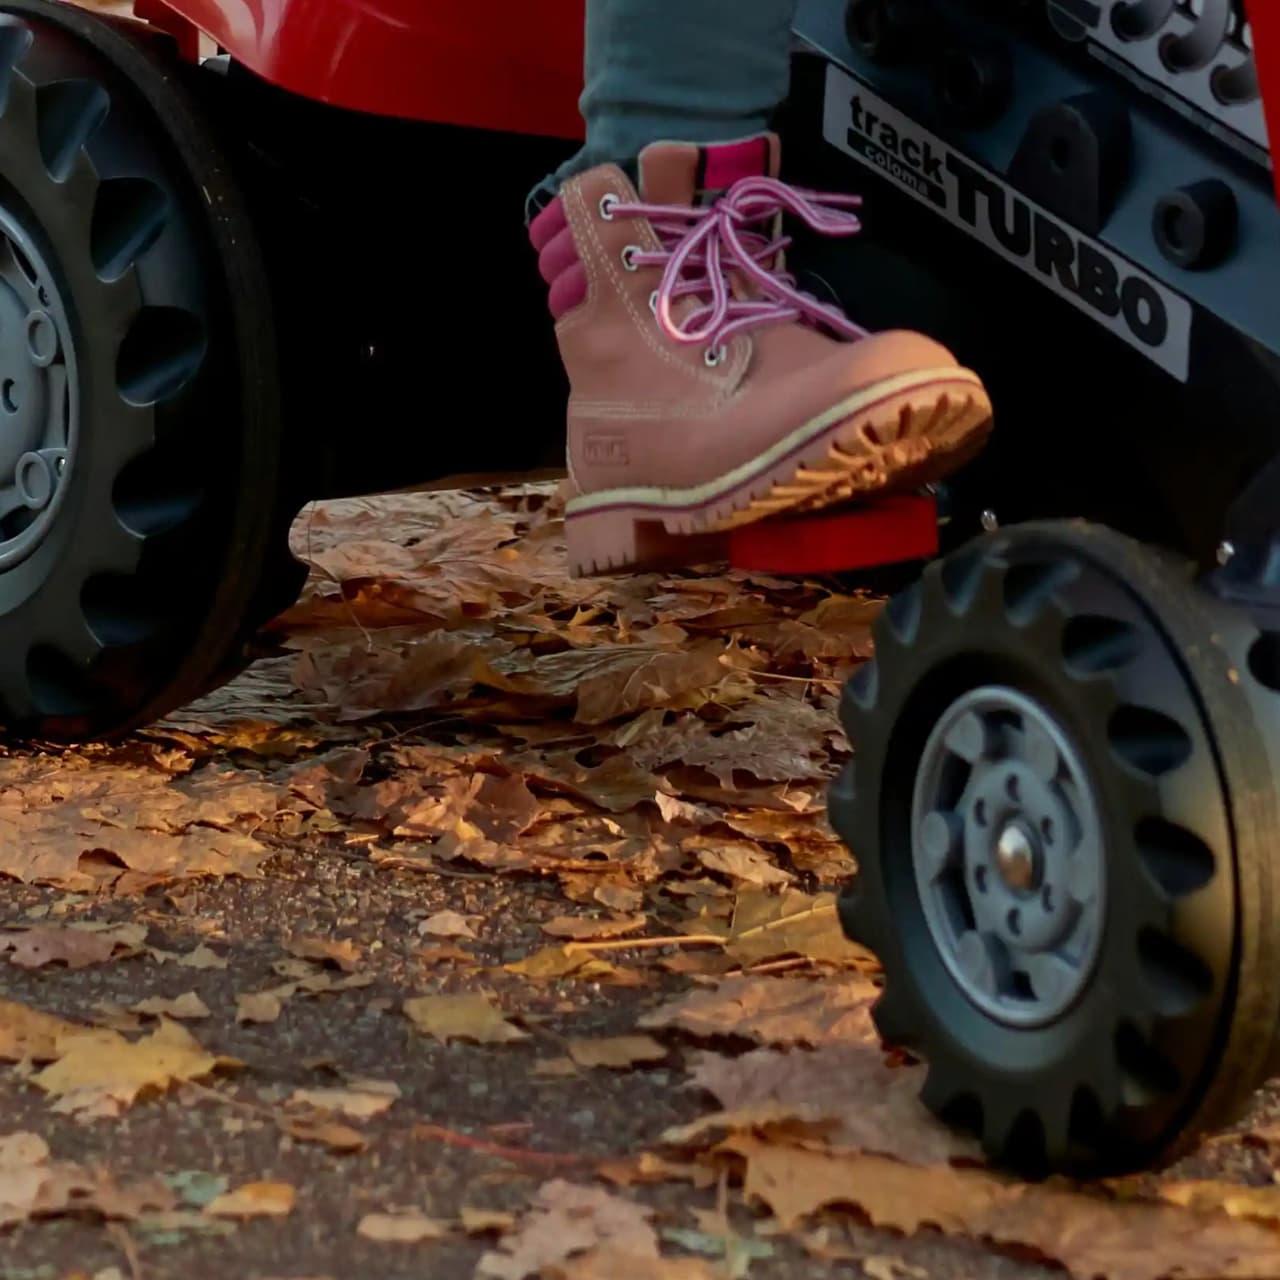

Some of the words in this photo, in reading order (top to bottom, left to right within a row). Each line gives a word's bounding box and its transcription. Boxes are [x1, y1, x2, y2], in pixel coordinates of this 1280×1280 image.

[848, 94, 946, 185] track
[945, 151, 1168, 349] TURBO
[864, 144, 930, 197] coloma
